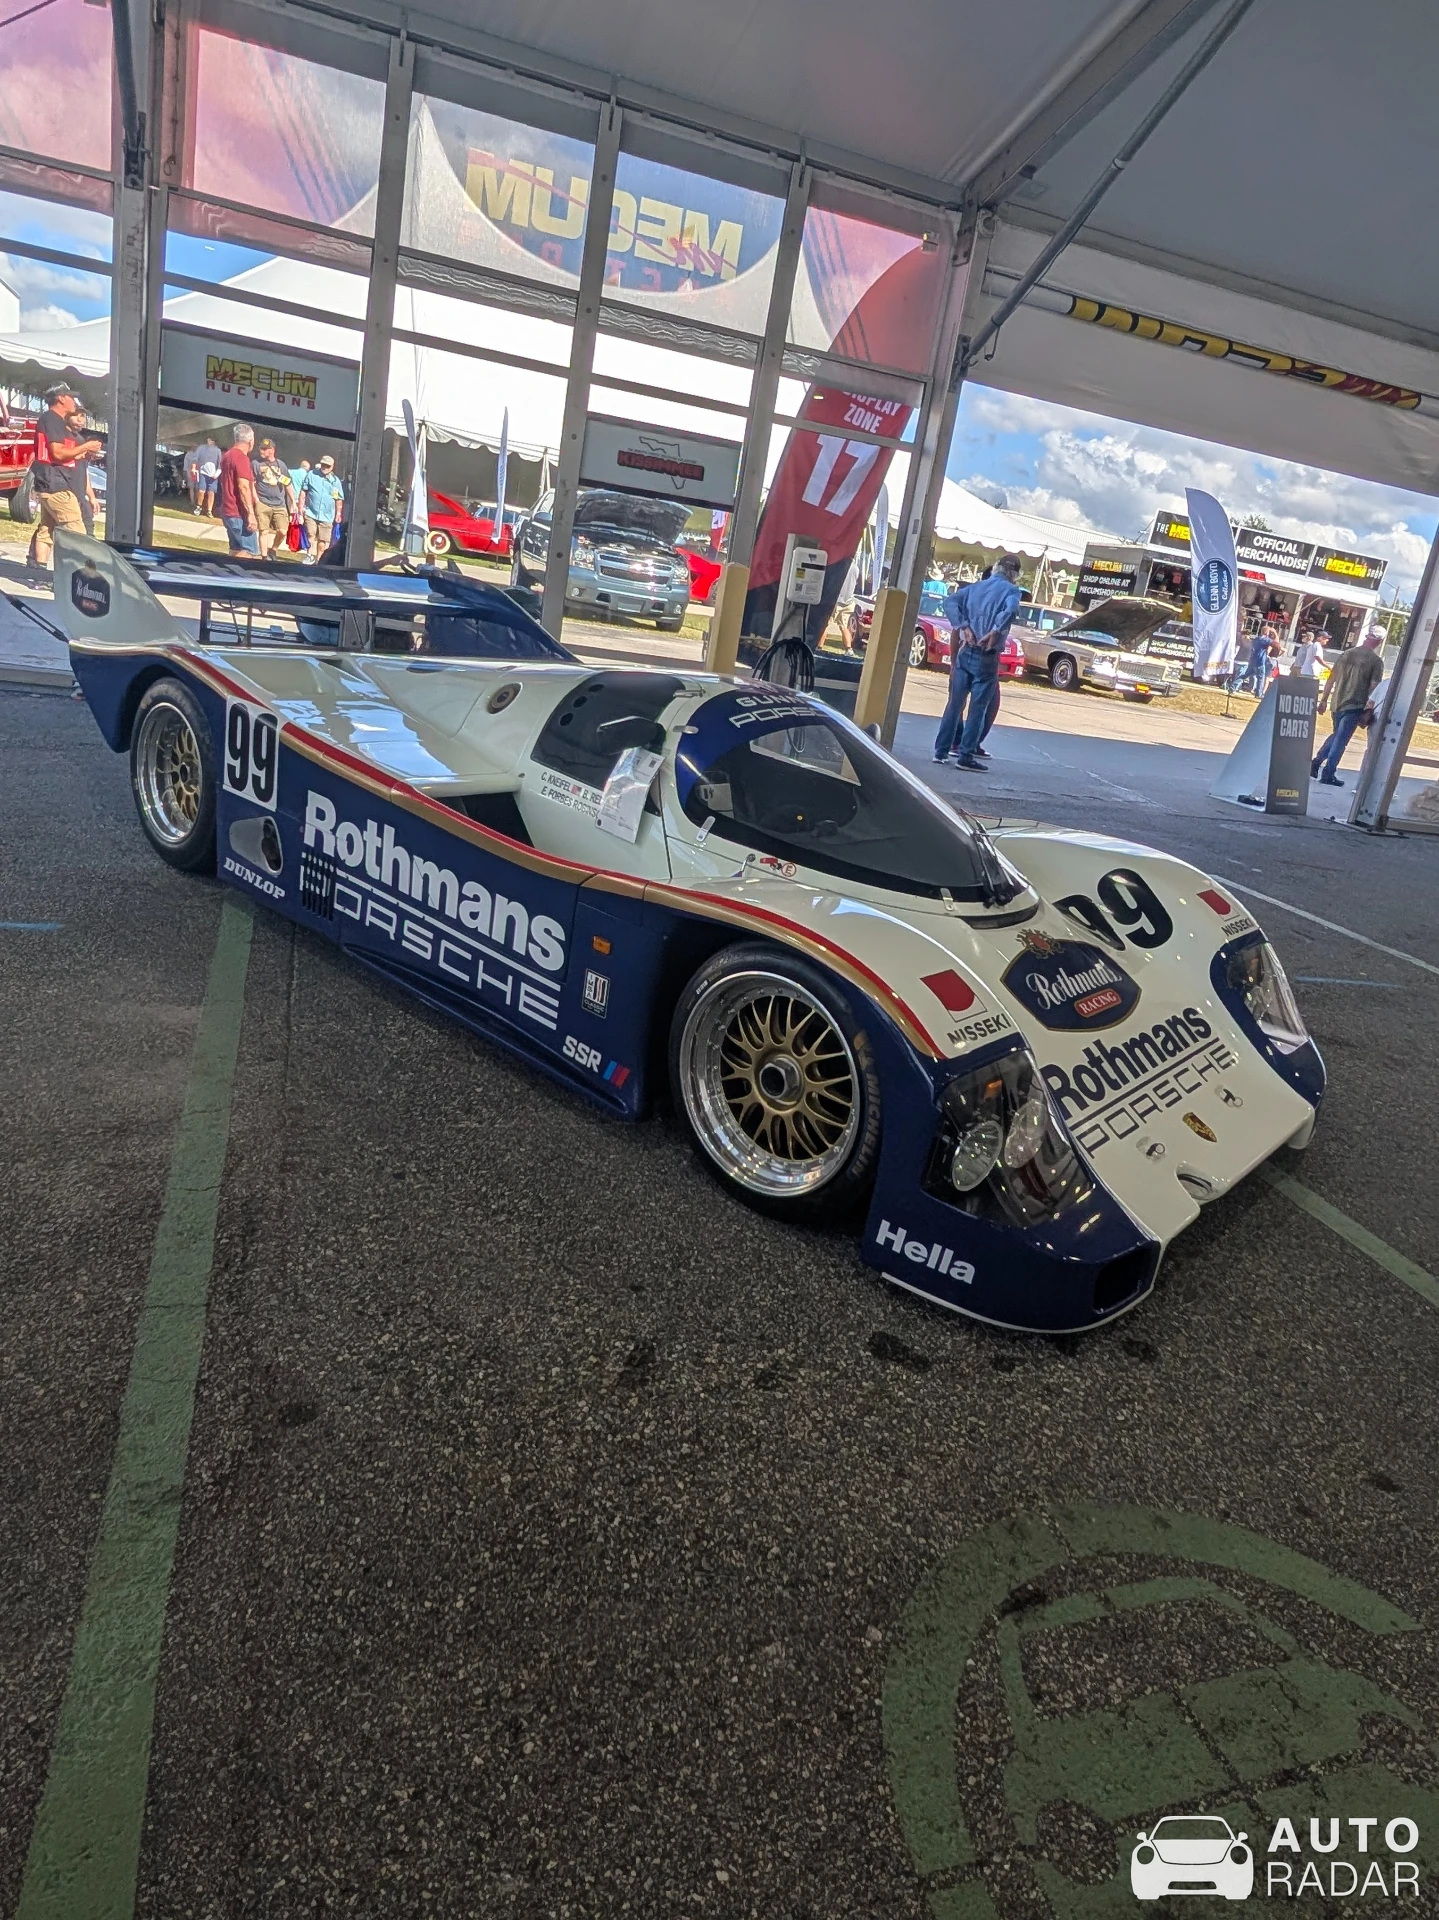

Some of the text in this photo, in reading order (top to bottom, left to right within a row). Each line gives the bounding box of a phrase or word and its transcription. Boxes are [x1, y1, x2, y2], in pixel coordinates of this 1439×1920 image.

[206, 355, 317, 400] MECUM
[206, 381, 315, 409] AUCTIONS
[842, 391, 901, 416] PLAY
[844, 403, 882, 433] ZONE
[802, 434, 881, 517] 17
[1156, 523, 1169, 534] THE
[1236, 545, 1308, 571] MERCHANDISE
[1253, 536, 1298, 555] OFFICIAL
[1083, 574, 1131, 587] SHOP ONLINE AT
[1093, 560, 1122, 573] MECUM
[1314, 556, 1384, 580] THE MECUM SHOP
[1079, 585, 1129, 597] MECUMSHOP.COM
[1210, 562, 1219, 611] GLENN BOYD
[1151, 640, 1166, 648] SHOP
[1167, 642, 1186, 651] ONLINE
[1279, 695, 1314, 716] NO GOLF
[1280, 718, 1309, 738] CARTS
[227, 702, 278, 802] 99
[541, 771, 547, 781] C.
[582, 789, 589, 800] B.
[548, 788, 572, 807] FORBES
[223, 857, 286, 900] DUNLOP
[304, 790, 566, 971] Rothmans
[1052, 868, 1173, 951] 99
[1221, 918, 1254, 936] NISSEKI
[586, 973, 594, 997] IMSA
[1025, 959, 1123, 1010] Rothmans
[1078, 990, 1118, 1014] RACING
[947, 1013, 1011, 1045] NISSEKI
[563, 1035, 602, 1073] SSR
[1038, 1007, 1212, 1119] Rothmans
[1075, 1043, 1238, 1159] PORSCHE
[851, 1073, 880, 1176] MICHELIN
[875, 1219, 975, 1284] Hella
